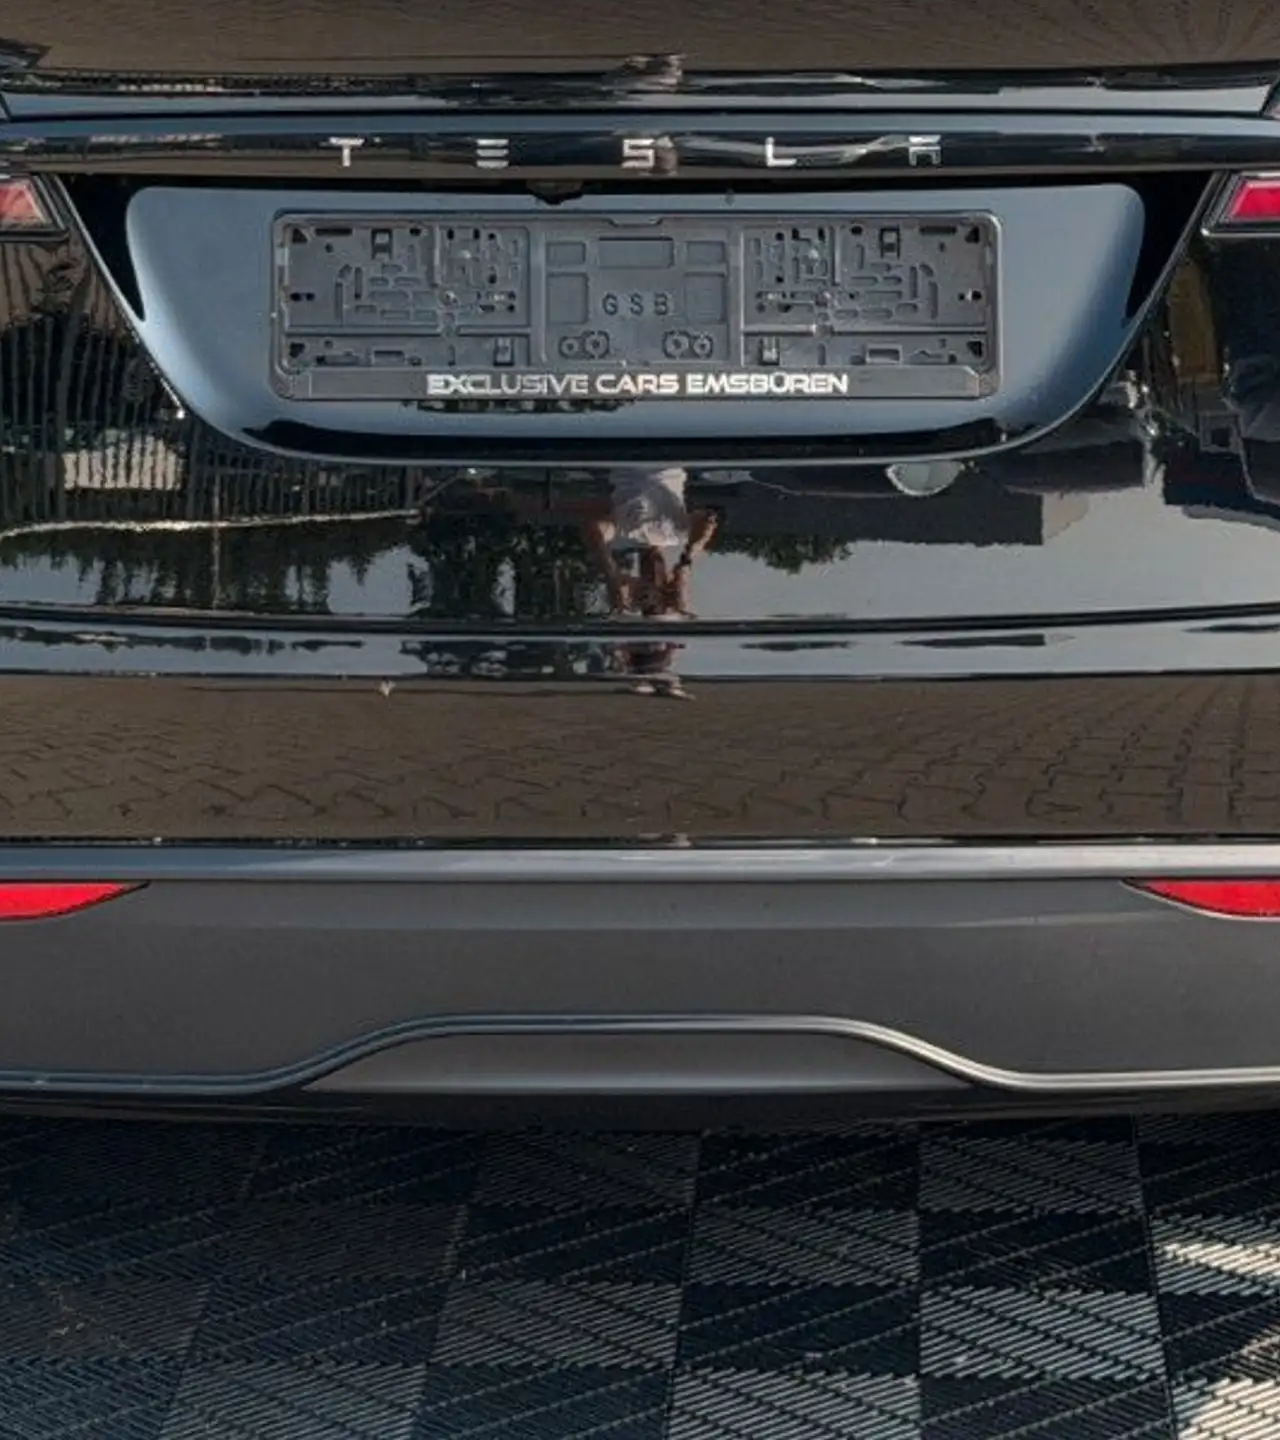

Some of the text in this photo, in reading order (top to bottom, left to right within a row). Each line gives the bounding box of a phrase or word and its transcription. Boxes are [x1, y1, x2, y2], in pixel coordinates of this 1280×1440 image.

[329, 135, 942, 169] TESLA
[426, 373, 589, 395] EXCLUSIVE
[595, 373, 679, 395] CARS
